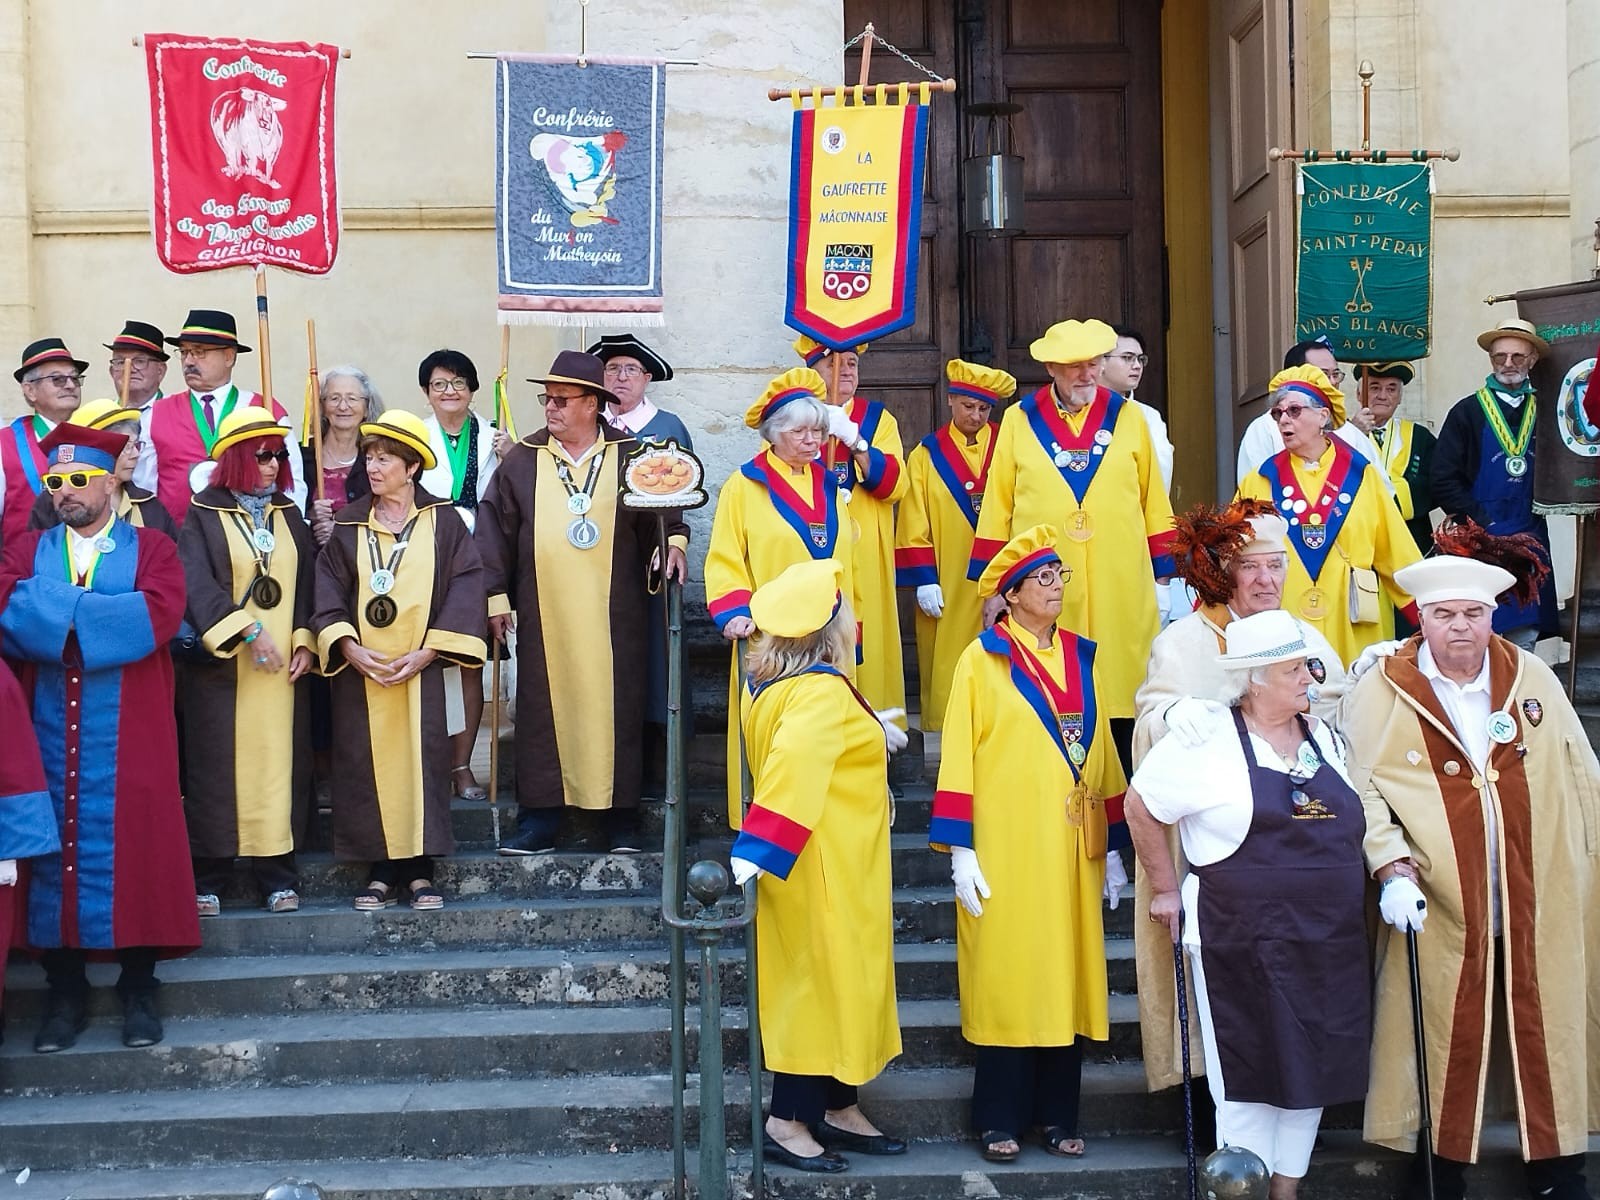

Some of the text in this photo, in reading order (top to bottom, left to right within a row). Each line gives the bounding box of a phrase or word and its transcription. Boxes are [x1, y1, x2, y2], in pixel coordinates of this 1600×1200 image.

[532, 106, 615, 132] Confrérie
[857, 151, 873, 165] LA
[822, 182, 887, 197] GAUFRETTE
[202, 199, 234, 218] des
[1308, 184, 1423, 216] CONFRERIE
[531, 207, 553, 225] du
[819, 208, 888, 223] MÂCONNAISE
[1353, 214, 1376, 226] DU
[177, 217, 204, 239] du
[198, 239, 300, 260] GUEUGNON
[827, 245, 872, 258] MACON
[1302, 233, 1427, 258] SAINT-PERAY
[543, 245, 623, 267] Matheysin
[1300, 315, 1427, 340] VINS BLANCS
[1343, 338, 1377, 350] AOC
